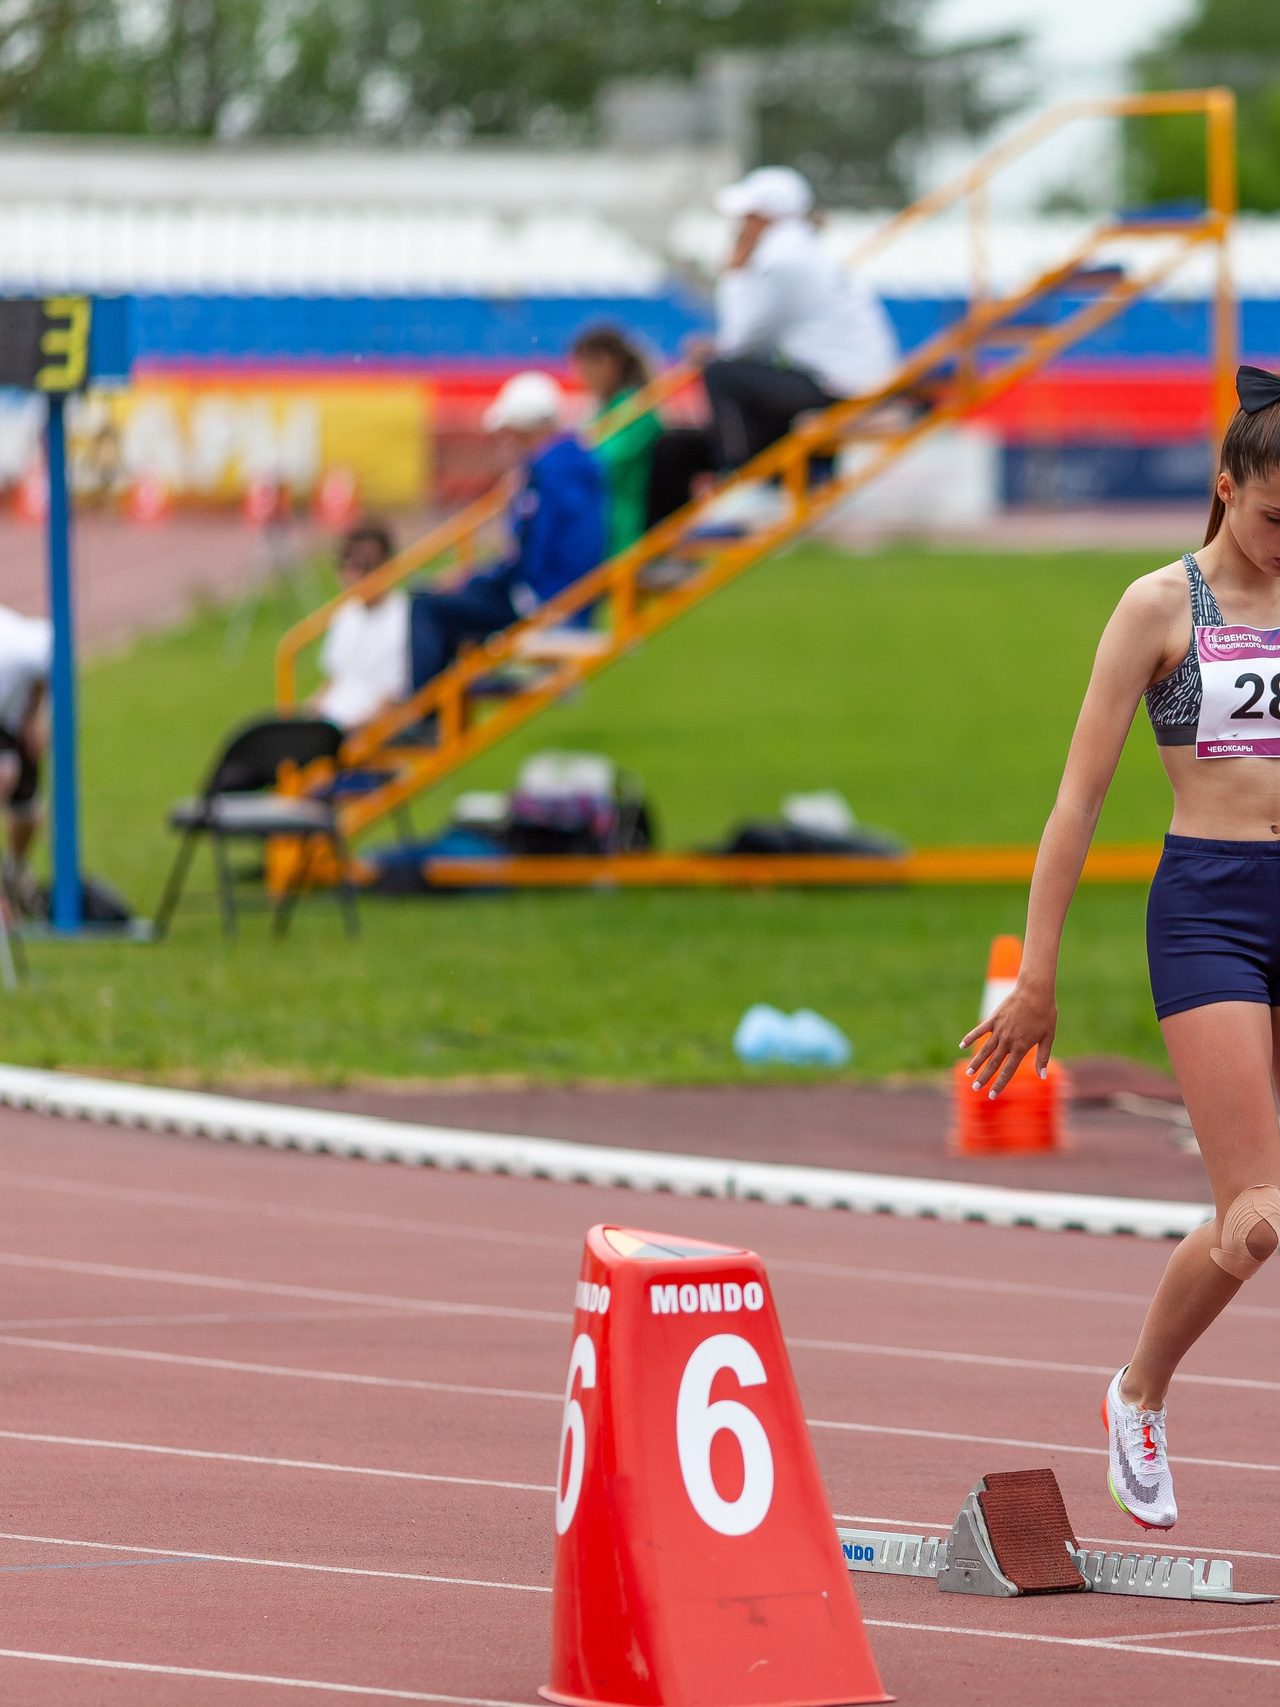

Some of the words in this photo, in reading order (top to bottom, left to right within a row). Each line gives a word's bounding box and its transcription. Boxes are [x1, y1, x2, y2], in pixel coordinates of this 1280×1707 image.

[36, 296, 92, 392] 3
[1207, 633, 1262, 643] ПЕРВЕНСТВО
[1207, 745, 1253, 753] ЧЕБОКСАРЫ
[650, 1282, 764, 1314] MONDO
[555, 1333, 596, 1536] 6
[676, 1333, 774, 1536] 6
